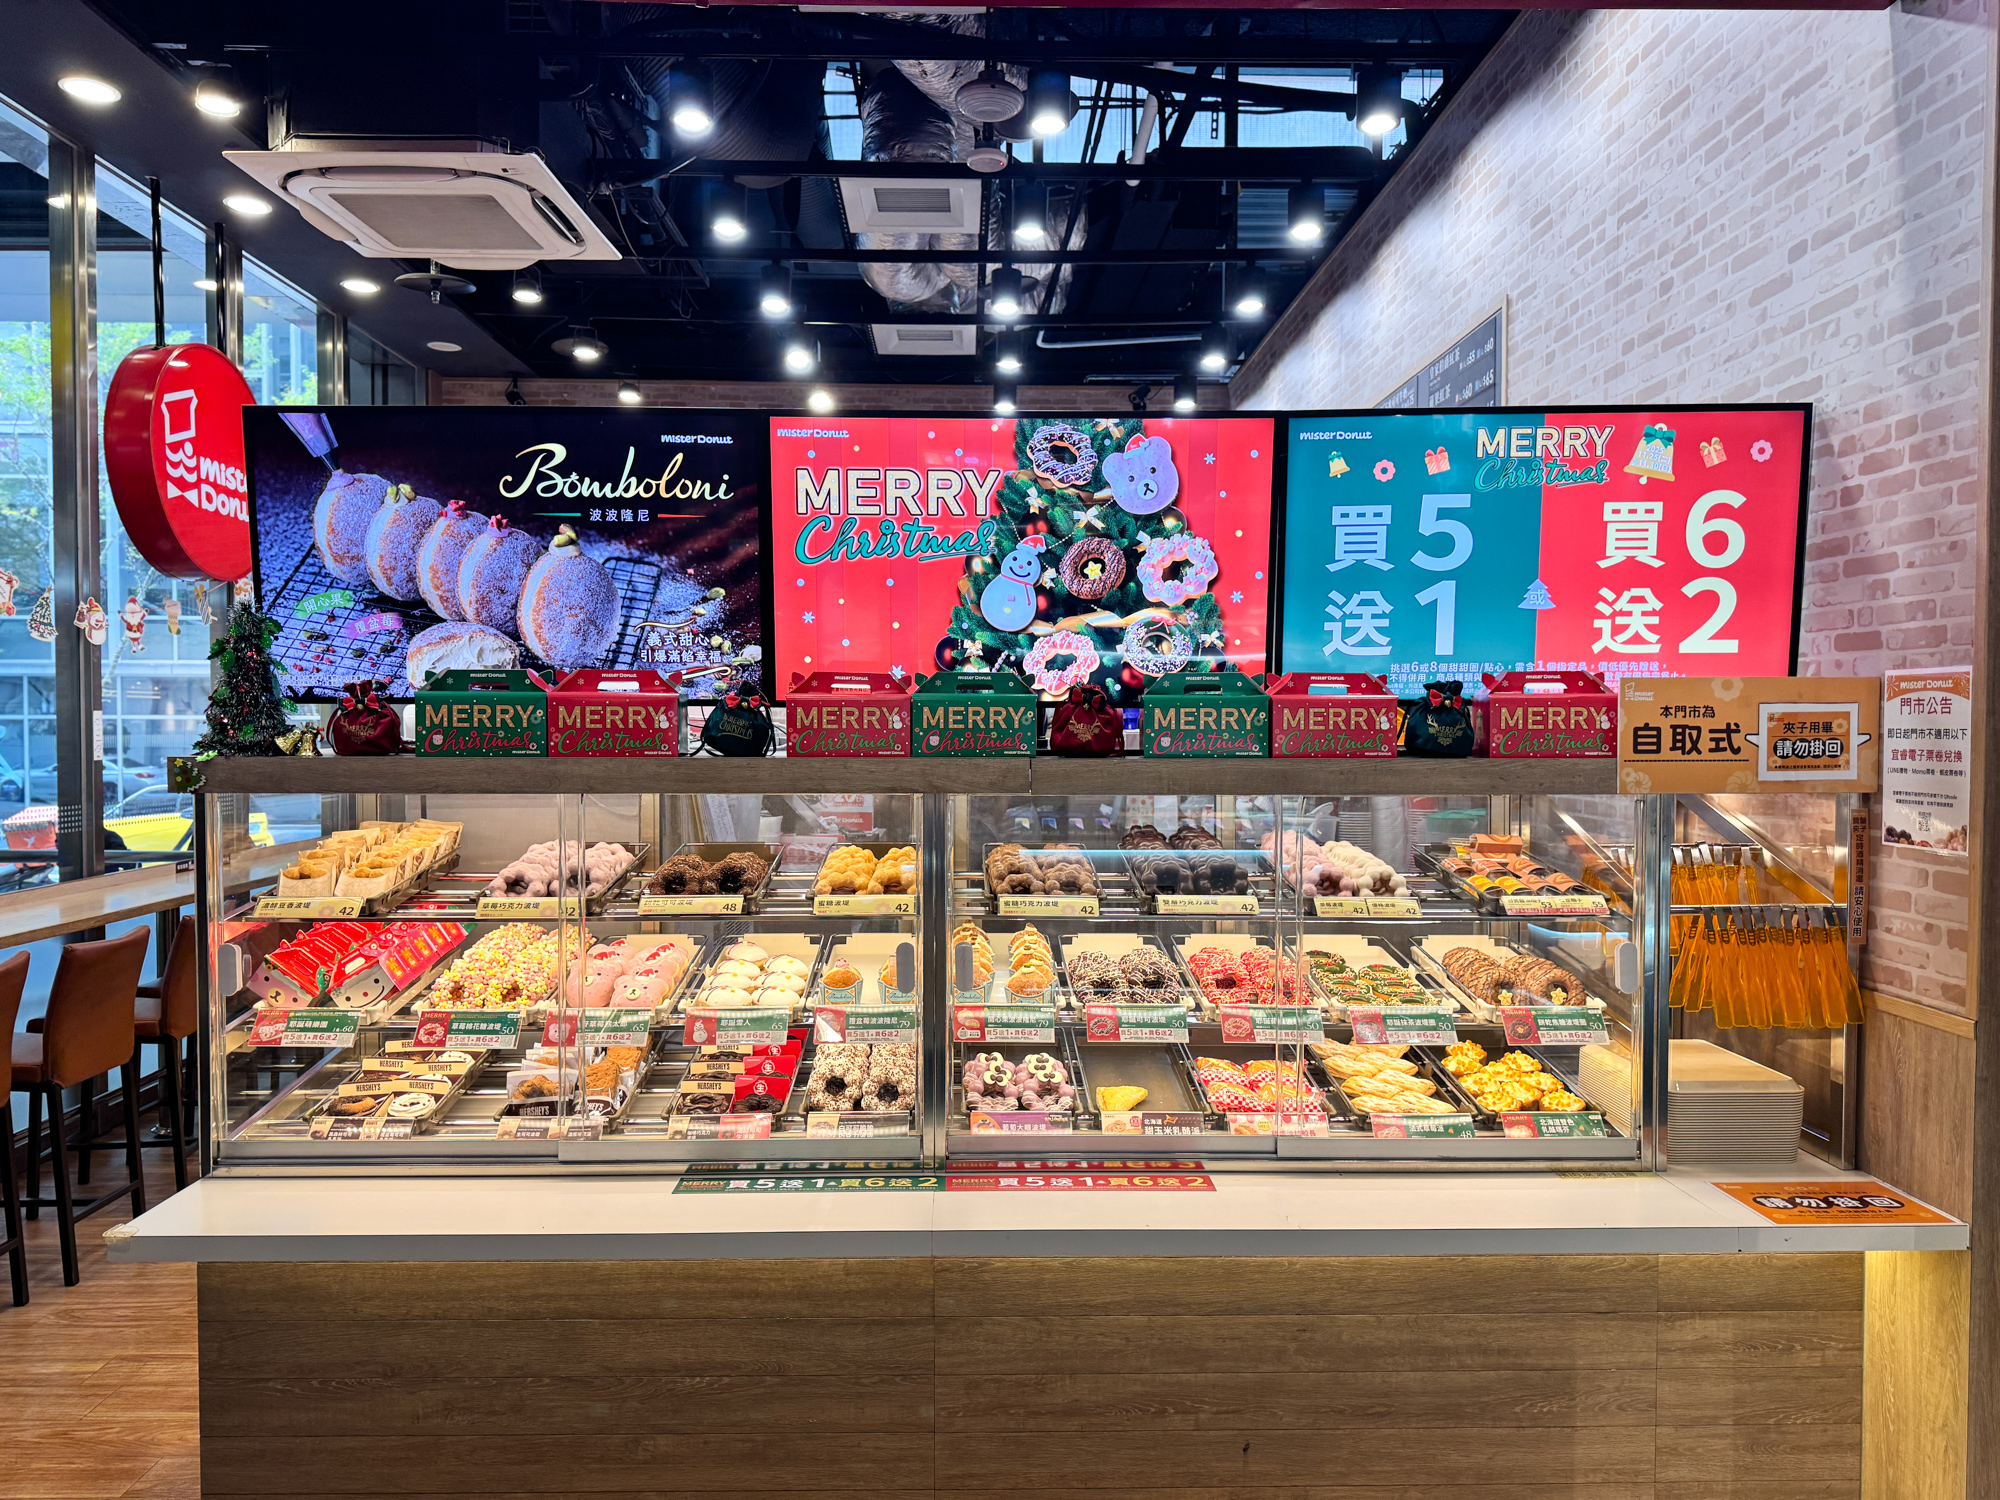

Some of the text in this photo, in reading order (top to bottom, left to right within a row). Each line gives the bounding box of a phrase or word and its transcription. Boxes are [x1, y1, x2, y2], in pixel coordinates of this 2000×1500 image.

[698, 434, 734, 445] Donut
[814, 429, 850, 440] Donut
[1336, 431, 1373, 441] Donut
[1476, 425, 1614, 458] MERRY
[499, 442, 735, 500] Bomboloni
[1473, 457, 1610, 492] Christmas
[795, 467, 1001, 517] MERRY
[589, 508, 650, 522] 波波隆尼
[795, 515, 997, 565] Christmas
[303, 593, 344, 613] 開心果
[1529, 589, 1546, 606] 或
[647, 632, 709, 647] 義式甜心
[1927, 679, 1954, 688] Donut
[1660, 705, 1716, 719] 本門市為
[1900, 697, 1952, 716] 門市公告
[425, 704, 534, 728] MERRY
[558, 706, 666, 729] MERRY
[796, 706, 900, 730] MERRY
[922, 706, 1027, 729] MERRY
[1154, 707, 1258, 730] MERRY
[1282, 707, 1387, 730] MERRY
[1501, 707, 1608, 730] MERRY
[1783, 721, 1834, 734] 夾子用畢
[1632, 722, 1742, 756] 自取式
[1887, 728, 1968, 741] 即日起門市不適用以下
[425, 728, 533, 753] Christmas
[558, 729, 664, 753] Christmas
[795, 730, 897, 754] Christmas
[922, 730, 1023, 753] Christmas
[1153, 731, 1255, 753] Christmas
[1282, 731, 1384, 754] Christmas
[1500, 731, 1605, 755] Christmas
[1776, 739, 1842, 757] 請勿掛回
[339, 907, 354, 916] 42
[482, 902, 541, 910] 草莓巧克力波堤
[722, 903, 737, 912] 48
[895, 903, 909, 913] 42
[1081, 905, 1095, 915] 42
[1241, 903, 1255, 912] 42
[1353, 907, 1365, 915] 42
[1405, 907, 1417, 915] 42
[1852, 886, 1865, 937] 請安心使用
[632, 1024, 645, 1032] 65
[771, 1022, 783, 1030] 65
[899, 1020, 911, 1028] 79
[1038, 1020, 1049, 1028] 79
[1172, 1020, 1185, 1028] 50
[1306, 1022, 1319, 1030] 50
[1438, 1022, 1452, 1031] 50
[1589, 1022, 1602, 1030] 50
[500, 1026, 515, 1034] 50
[770, 1047, 779, 1055] 生
[380, 1060, 404, 1068] HERSHEY'S
[428, 1064, 452, 1072] HERSHEY'S
[706, 1063, 731, 1071] HERSHEY'S
[763, 1063, 772, 1072] 生
[356, 1083, 381, 1092] HERSHEY'S
[409, 1081, 434, 1090] HERSHEY'S
[697, 1082, 722, 1090] HERSHEY'S
[756, 1083, 765, 1092] 生
[519, 1105, 550, 1116] HERSHEY'S
[1144, 1126, 1200, 1135] 甜玉米乳酪派
[1460, 1130, 1473, 1139] 48
[1591, 1128, 1603, 1136] 45
[726, 1177, 939, 1189] 買5送1 買6送2
[998, 1176, 1208, 1186] 買5送1 買6送2
[1756, 1197, 1902, 1208] 請勿掛回
